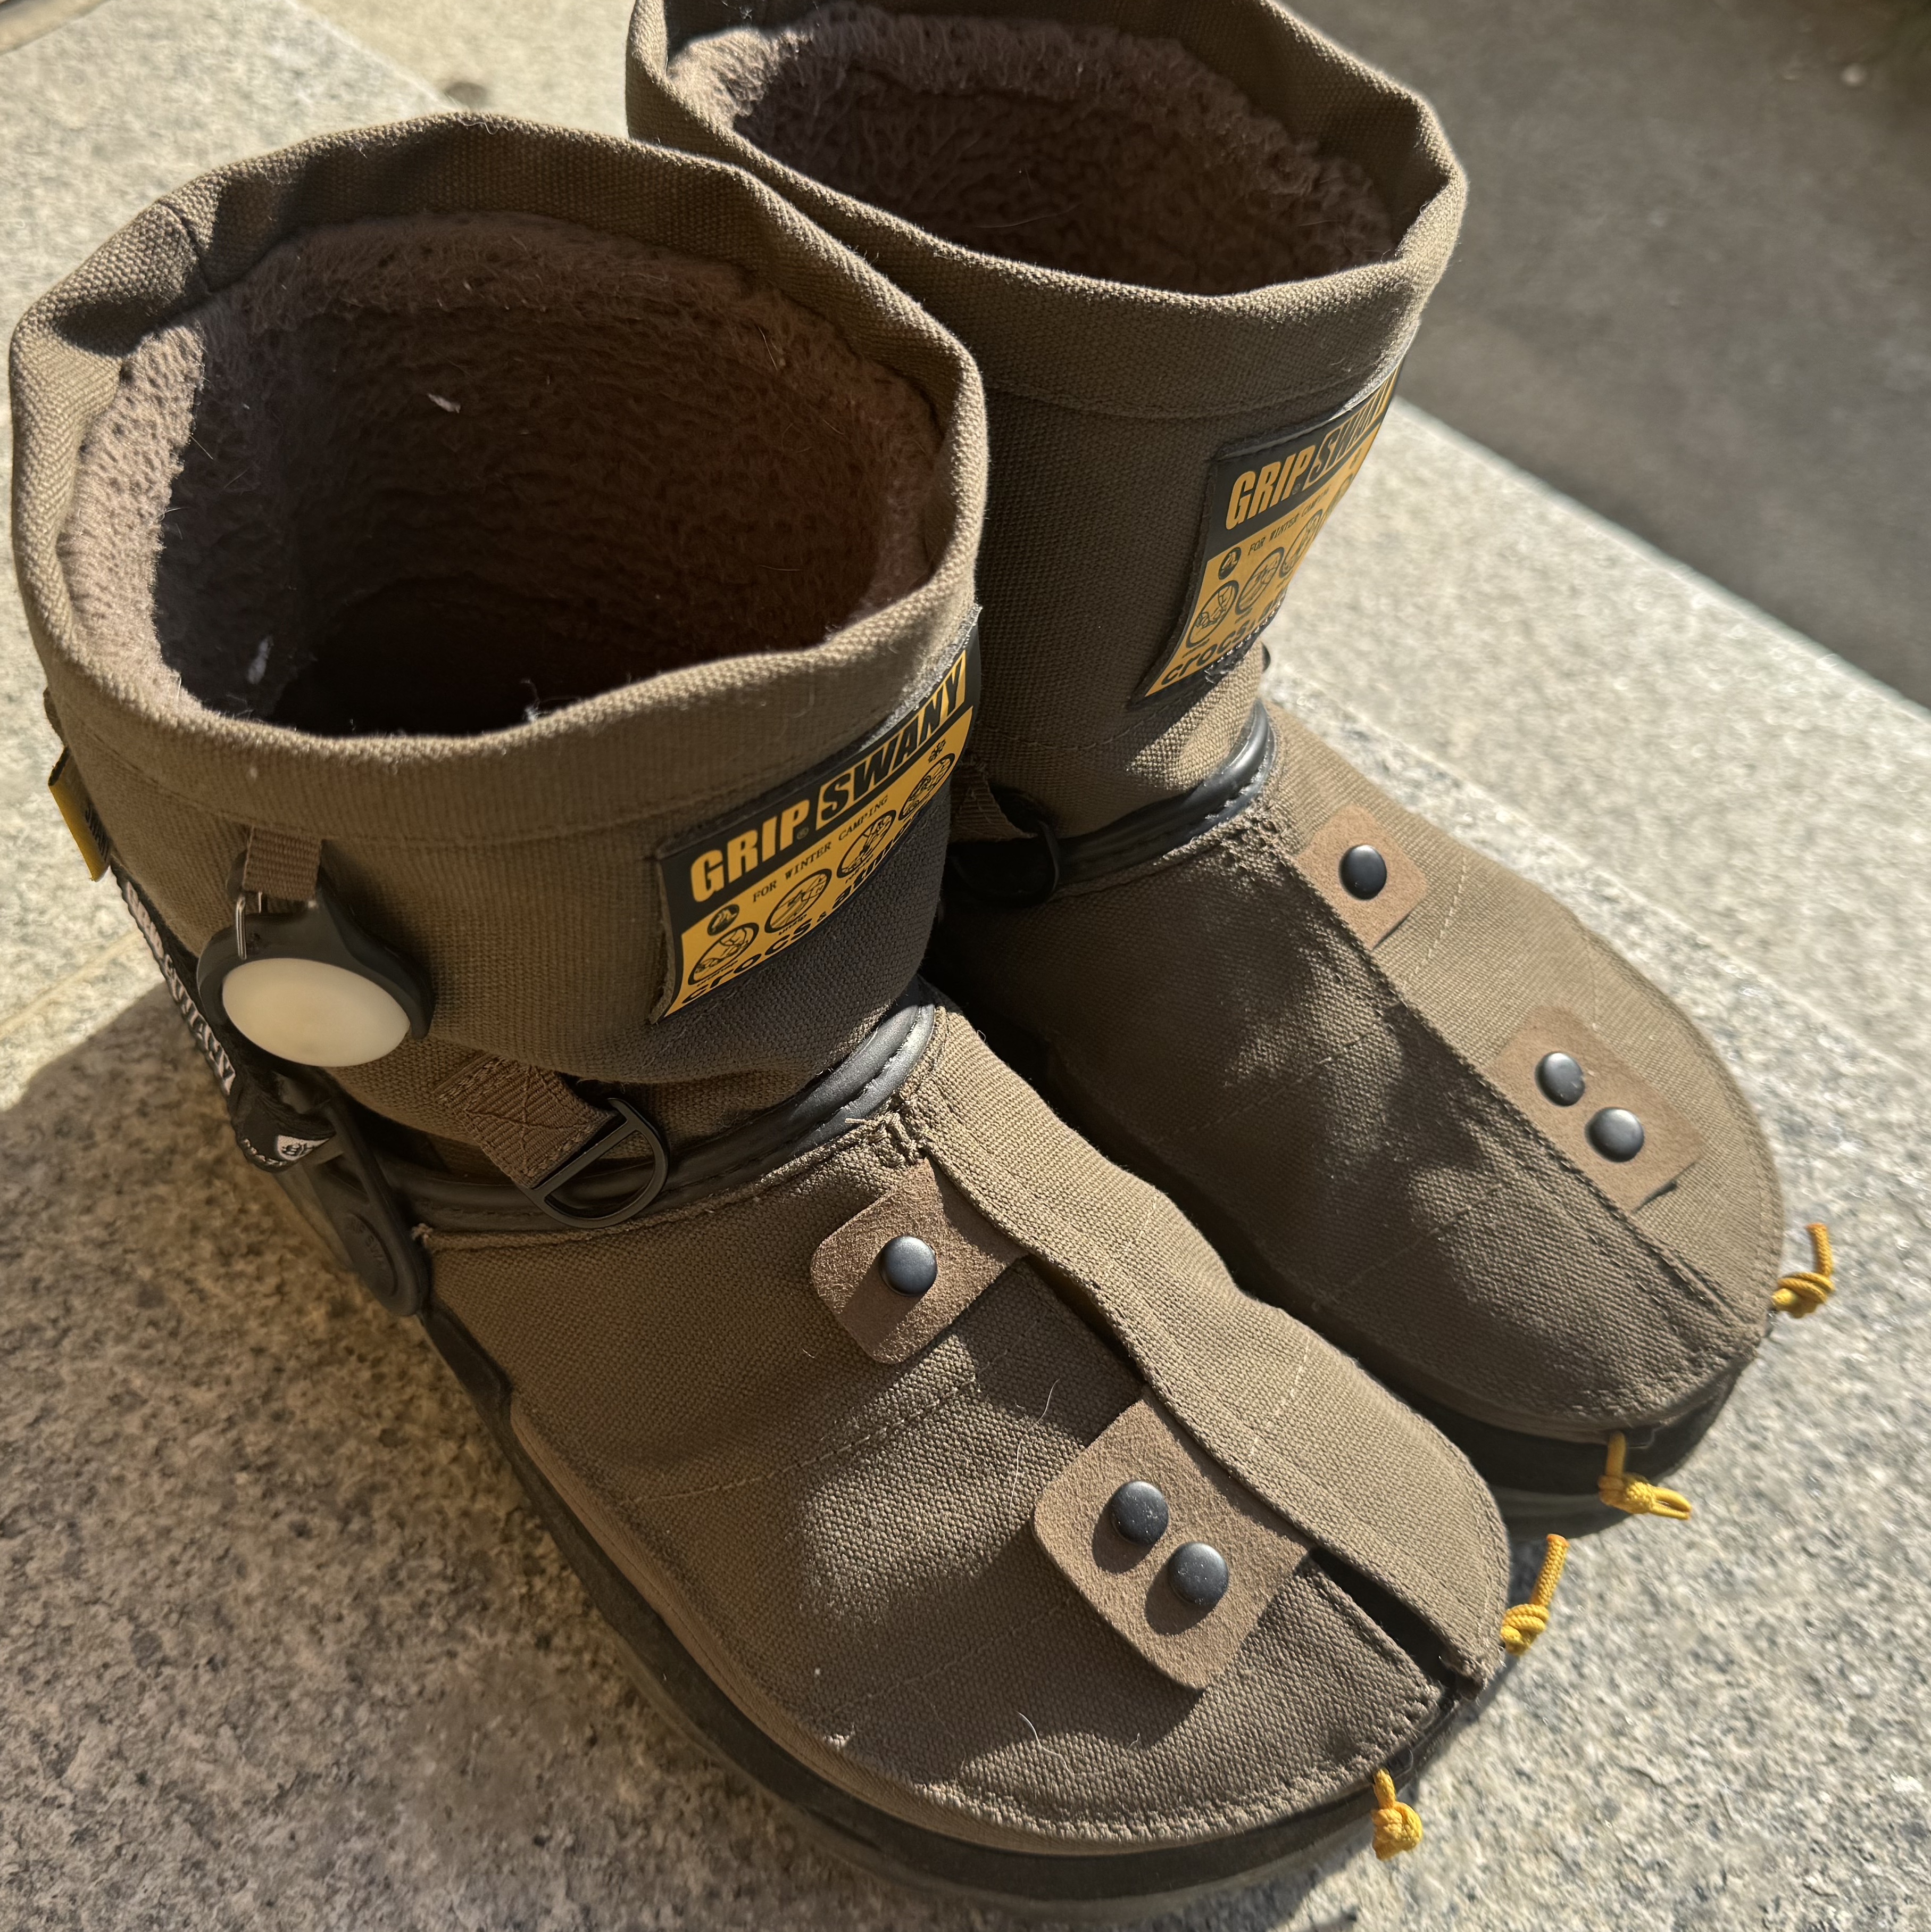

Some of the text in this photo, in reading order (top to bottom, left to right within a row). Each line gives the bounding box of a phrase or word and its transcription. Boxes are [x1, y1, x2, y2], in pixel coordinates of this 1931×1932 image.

[1226, 445, 1316, 530] GRIP
[1247, 536, 1266, 556] FOR
[1161, 620, 1250, 685] crocs
[690, 656, 963, 902] GRIP SWANY
[752, 880, 777, 903] FOR
[785, 841, 831, 880] WINTER
[838, 795, 888, 841] CAMPING
[681, 918, 812, 1004] crocs
